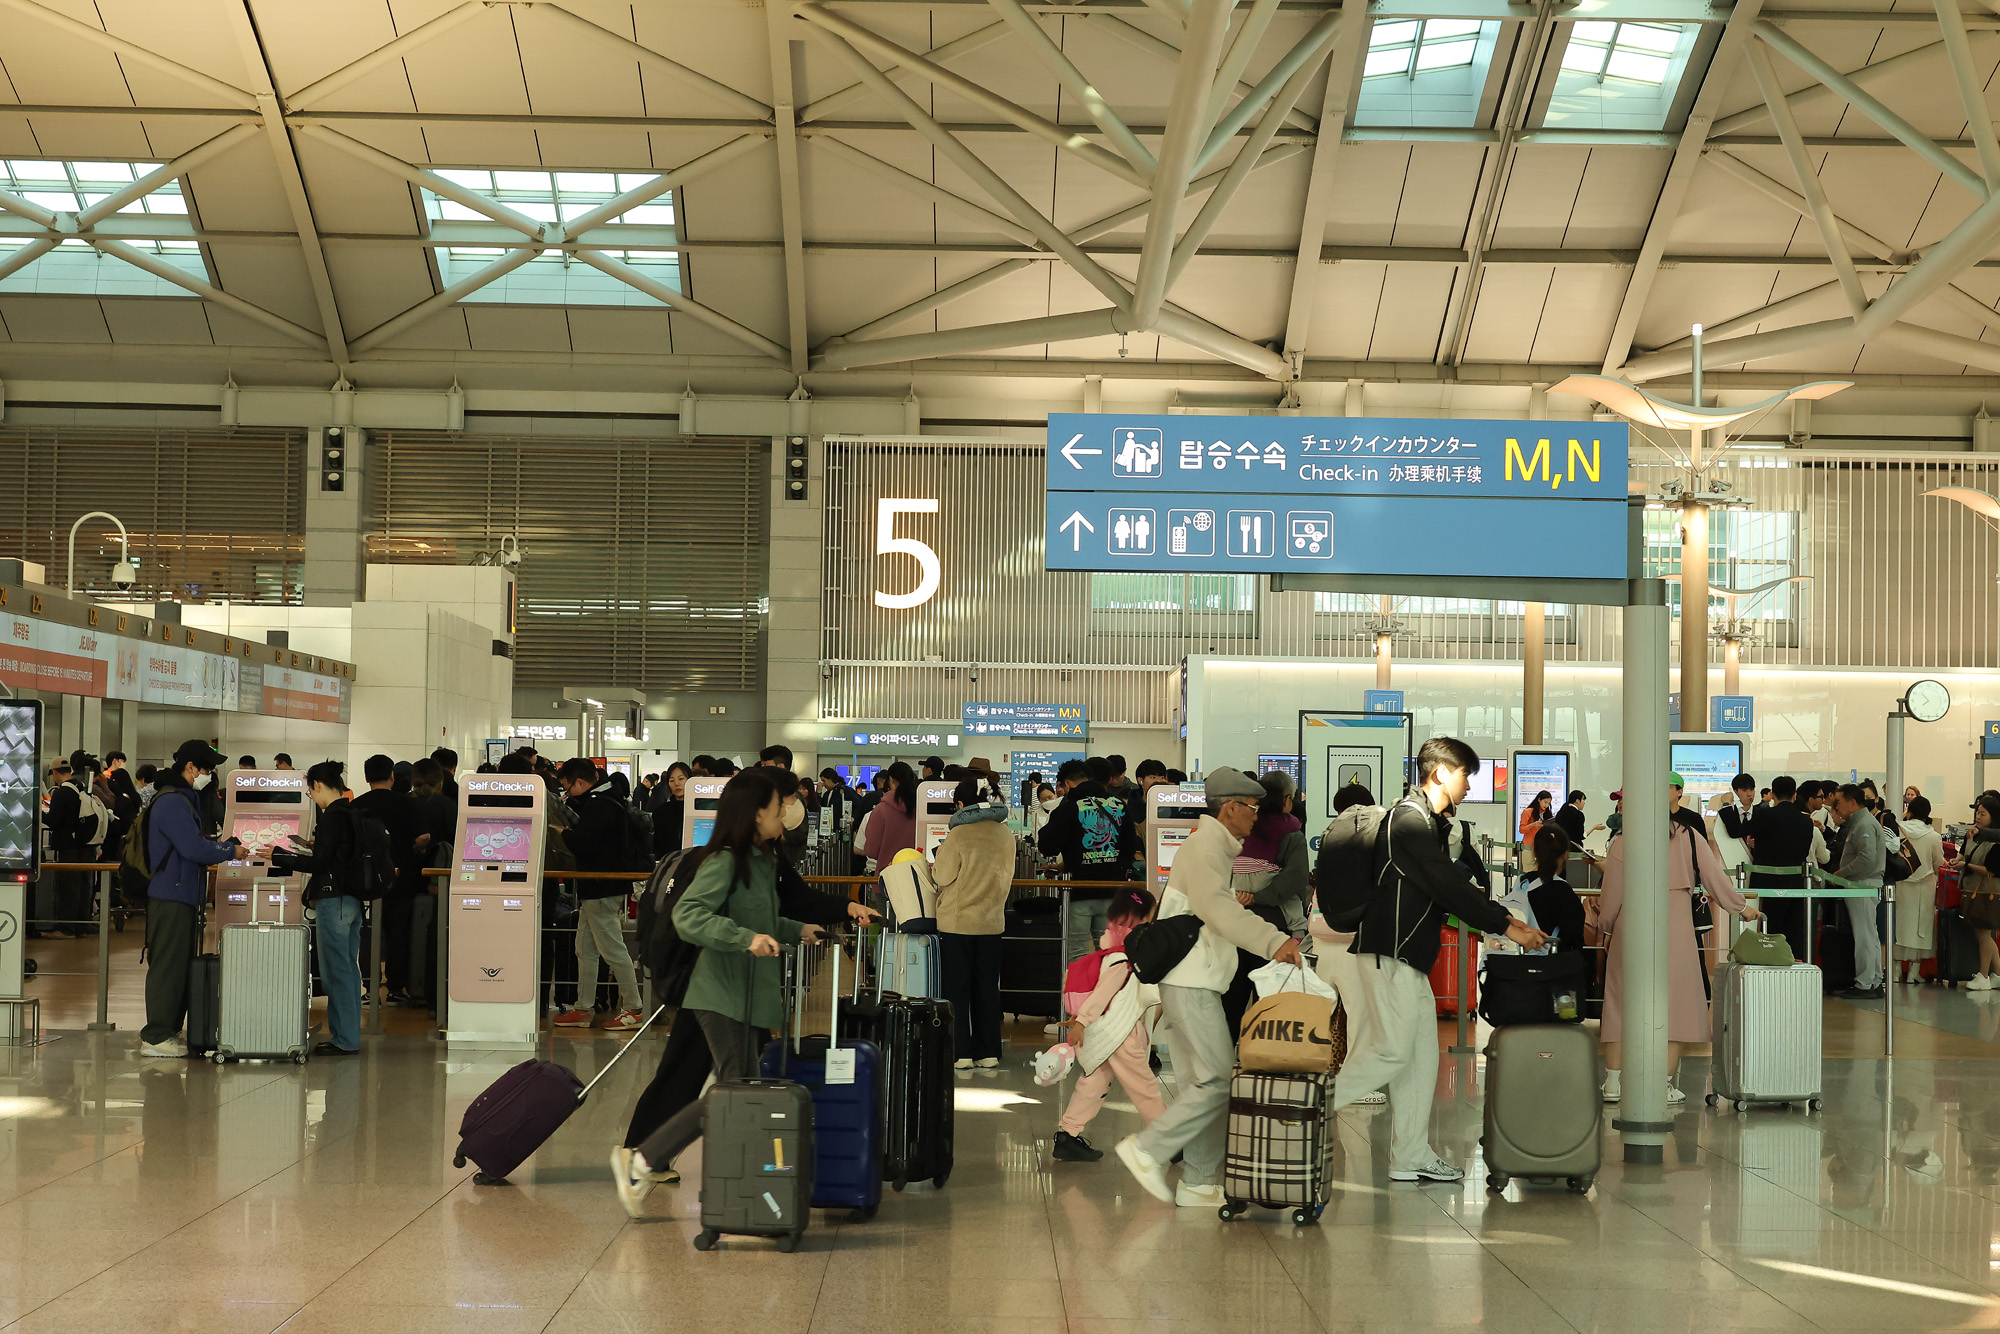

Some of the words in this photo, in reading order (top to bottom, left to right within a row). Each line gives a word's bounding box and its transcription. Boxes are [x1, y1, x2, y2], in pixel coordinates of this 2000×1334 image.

[1300, 434, 1478, 454] チェックインカウンター
[1179, 439, 1287, 471] 탑승수속
[1504, 437, 1601, 490] M,N
[1299, 463, 1379, 482] Check-in
[1388, 463, 1483, 484] 办理乘机手续
[874, 497, 941, 610] 5
[1059, 707, 1081, 719] M,N
[516, 725, 567, 740] 국민은행
[1060, 724, 1083, 735] K-A
[1991, 723, 2000, 735] 6
[869, 733, 940, 747] 와이파이도시락
[236, 776, 256, 787] Self
[258, 776, 303, 787] Check-in
[468, 780, 488, 791] Self
[490, 781, 535, 792] Check-in
[694, 783, 715, 794] Self
[926, 788, 947, 799] Self
[1157, 792, 1178, 803] Self
[1179, 793, 1206, 803] Chec
[1252, 1020, 1305, 1043] NIKE
